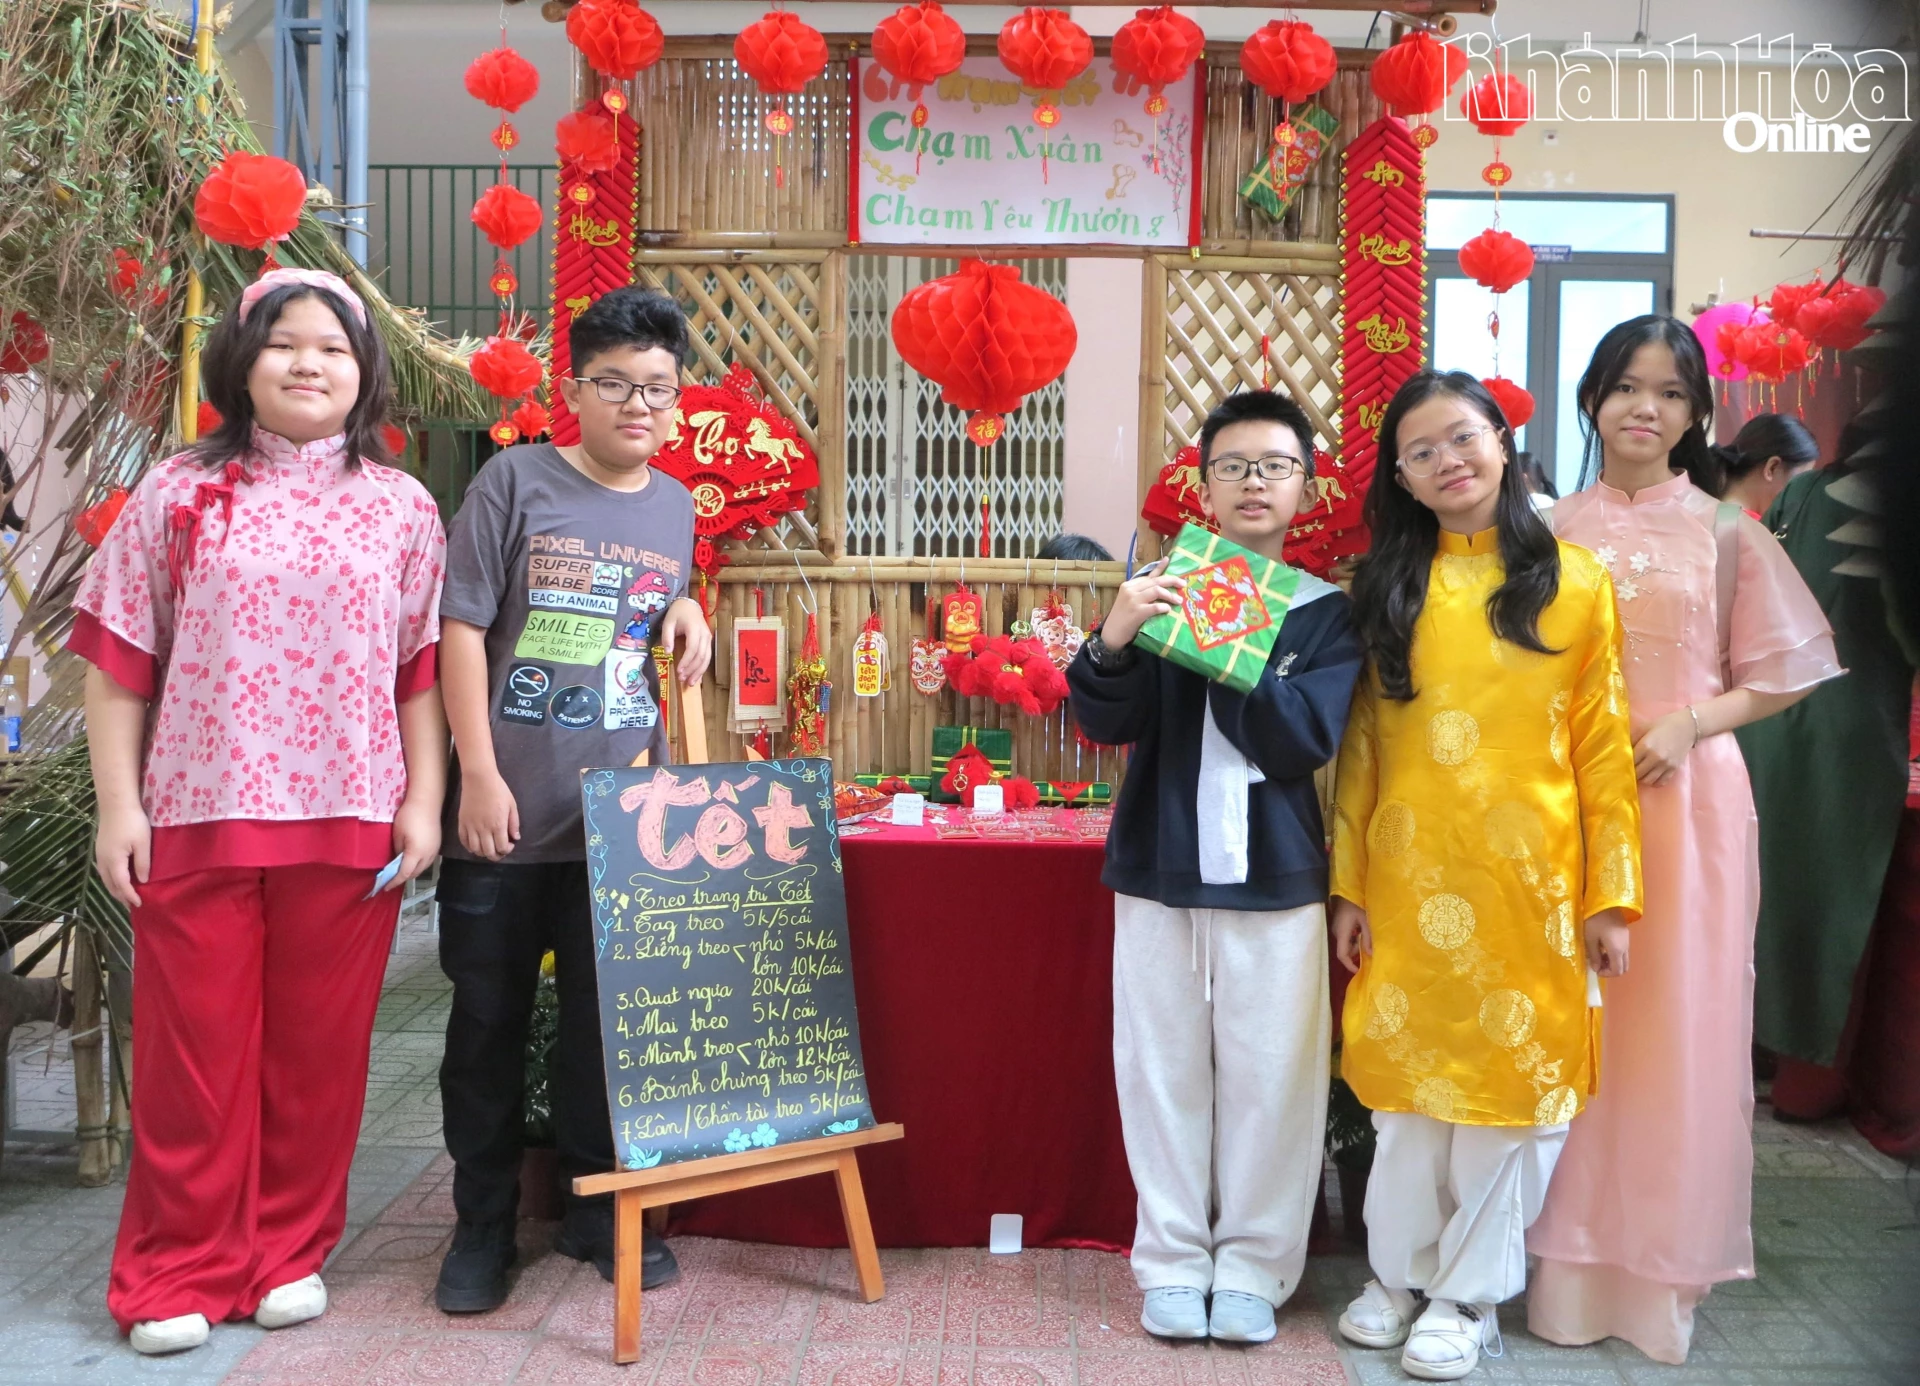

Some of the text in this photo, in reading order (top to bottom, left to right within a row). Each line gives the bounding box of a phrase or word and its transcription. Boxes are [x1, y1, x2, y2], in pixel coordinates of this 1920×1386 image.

[867, 110, 1103, 166] Chạm Xuân
[865, 193, 1165, 238] Chạm Yêu Thương
[688, 410, 740, 465] Thọ
[975, 418, 996, 439] 福
[530, 535, 594, 557] PIXEL
[532, 558, 591, 574] SUPER
[535, 575, 585, 590] MABE
[591, 586, 619, 597] SCORE
[531, 592, 615, 611] EACH ANIMAL
[527, 617, 588, 637] SMILE
[522, 633, 602, 650] FACE LIFE WITH
[548, 647, 582, 659] SMILE
[517, 698, 532, 707] NO
[616, 696, 647, 706] NO ARE
[503, 706, 543, 719] SMOKING
[558, 712, 593, 724] PATIENCE
[620, 715, 648, 727] HERE
[619, 766, 815, 870] Tết
[635, 877, 812, 912] Treo trang trí Tết
[634, 914, 677, 943] Tag
[685, 914, 724, 931] treo
[697, 938, 730, 955] treo
[749, 930, 784, 951] nhỏ
[752, 952, 844, 979] lớn 10k/cái
[751, 977, 812, 996] 20k/cái
[690, 1008, 729, 1031] treo
[639, 1036, 697, 1067] Mành
[703, 1038, 734, 1057] treo
[755, 1026, 790, 1049] nhỏ
[795, 1017, 849, 1044] 10k/cái
[796, 1042, 851, 1068] 12k/cái
[640, 1068, 706, 1103] Bánh
[711, 1060, 771, 1097] chưng
[778, 1068, 807, 1086] treo
[745, 1102, 769, 1123] tài
[775, 1098, 803, 1119] treo
